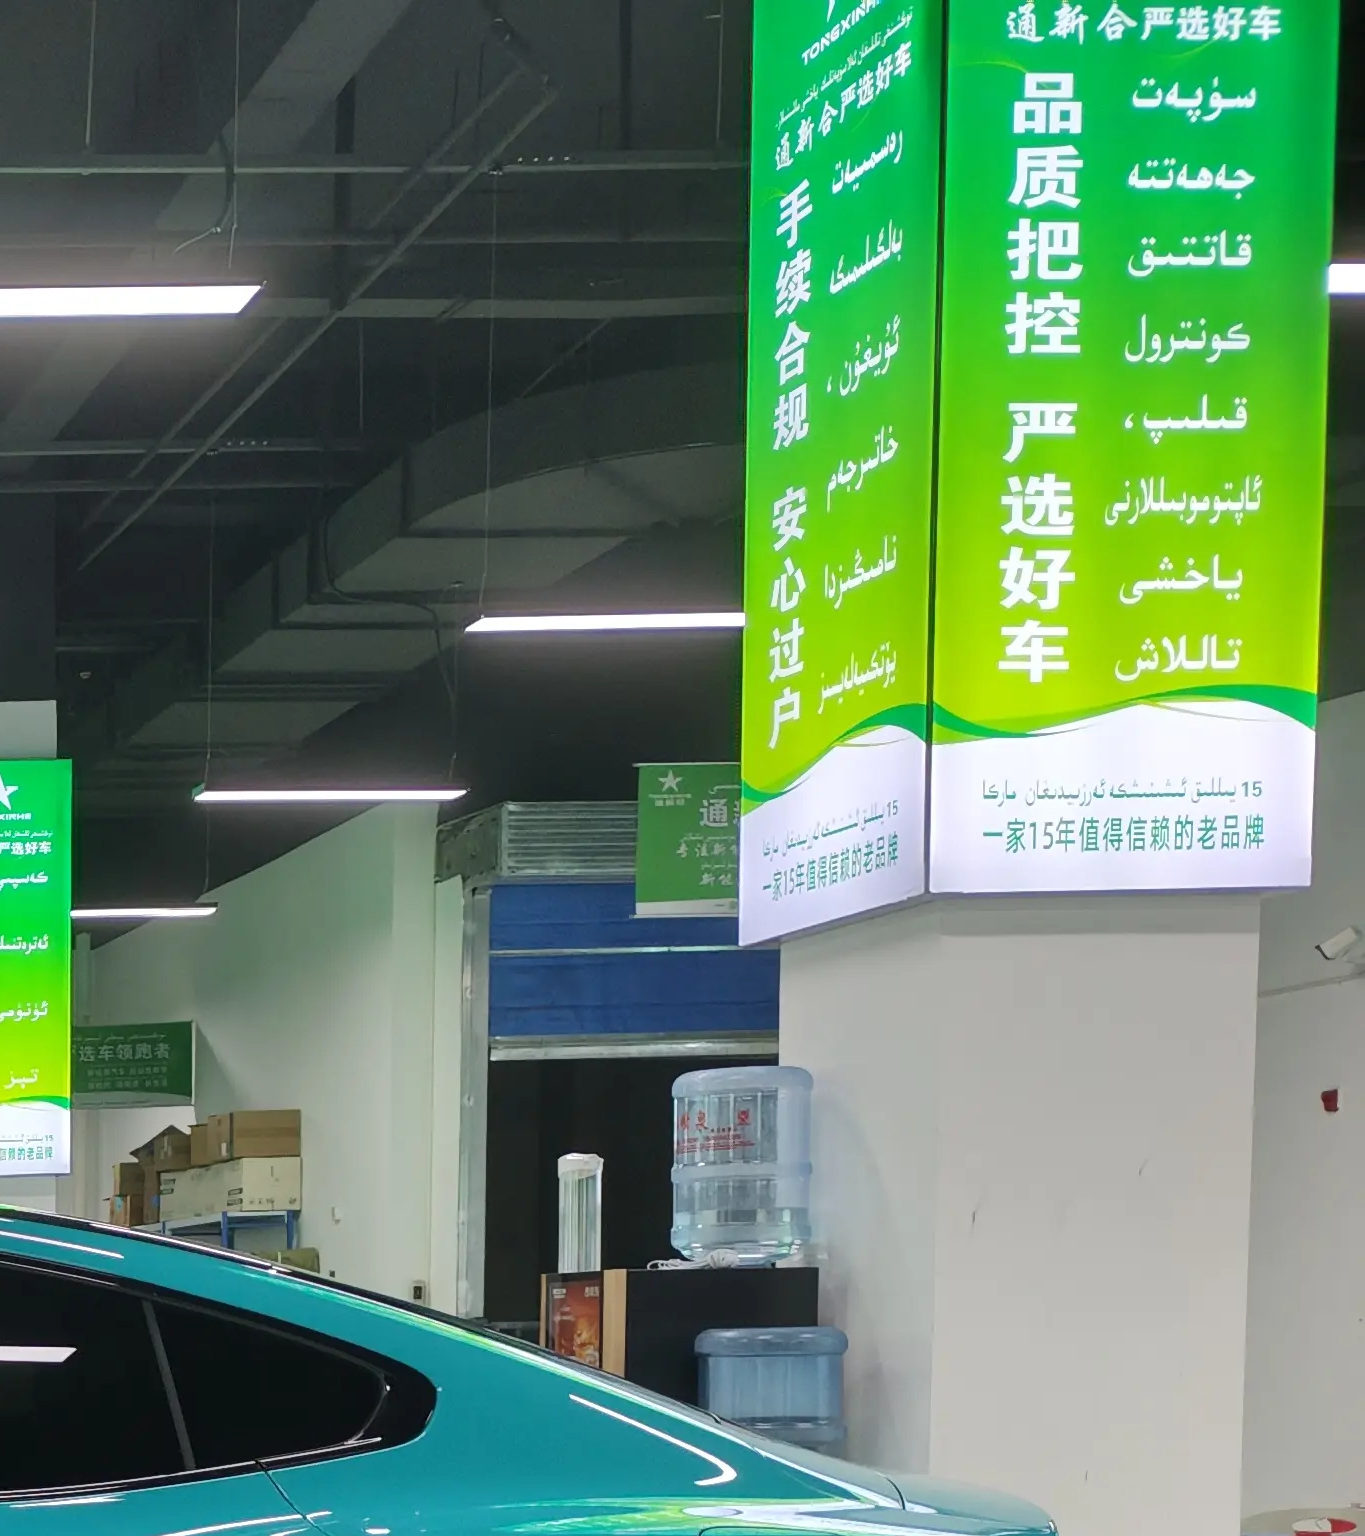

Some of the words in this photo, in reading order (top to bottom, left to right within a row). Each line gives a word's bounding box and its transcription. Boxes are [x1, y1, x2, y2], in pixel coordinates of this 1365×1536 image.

[1005, 5, 1282, 45] 通新合严选好车
[1004, 72, 1084, 356] 品质把控
[772, 176, 813, 455] 手续合规
[997, 401, 1078, 685] 严选好车
[768, 484, 808, 750] 安心过户
[1241, 781, 1263, 799] 15
[762, 830, 899, 901] 一家15年值得信赖的老品牌
[982, 813, 1265, 854] 一家15年值得信赖的老品牌
[72, 1042, 171, 1062] 选车领跑者
